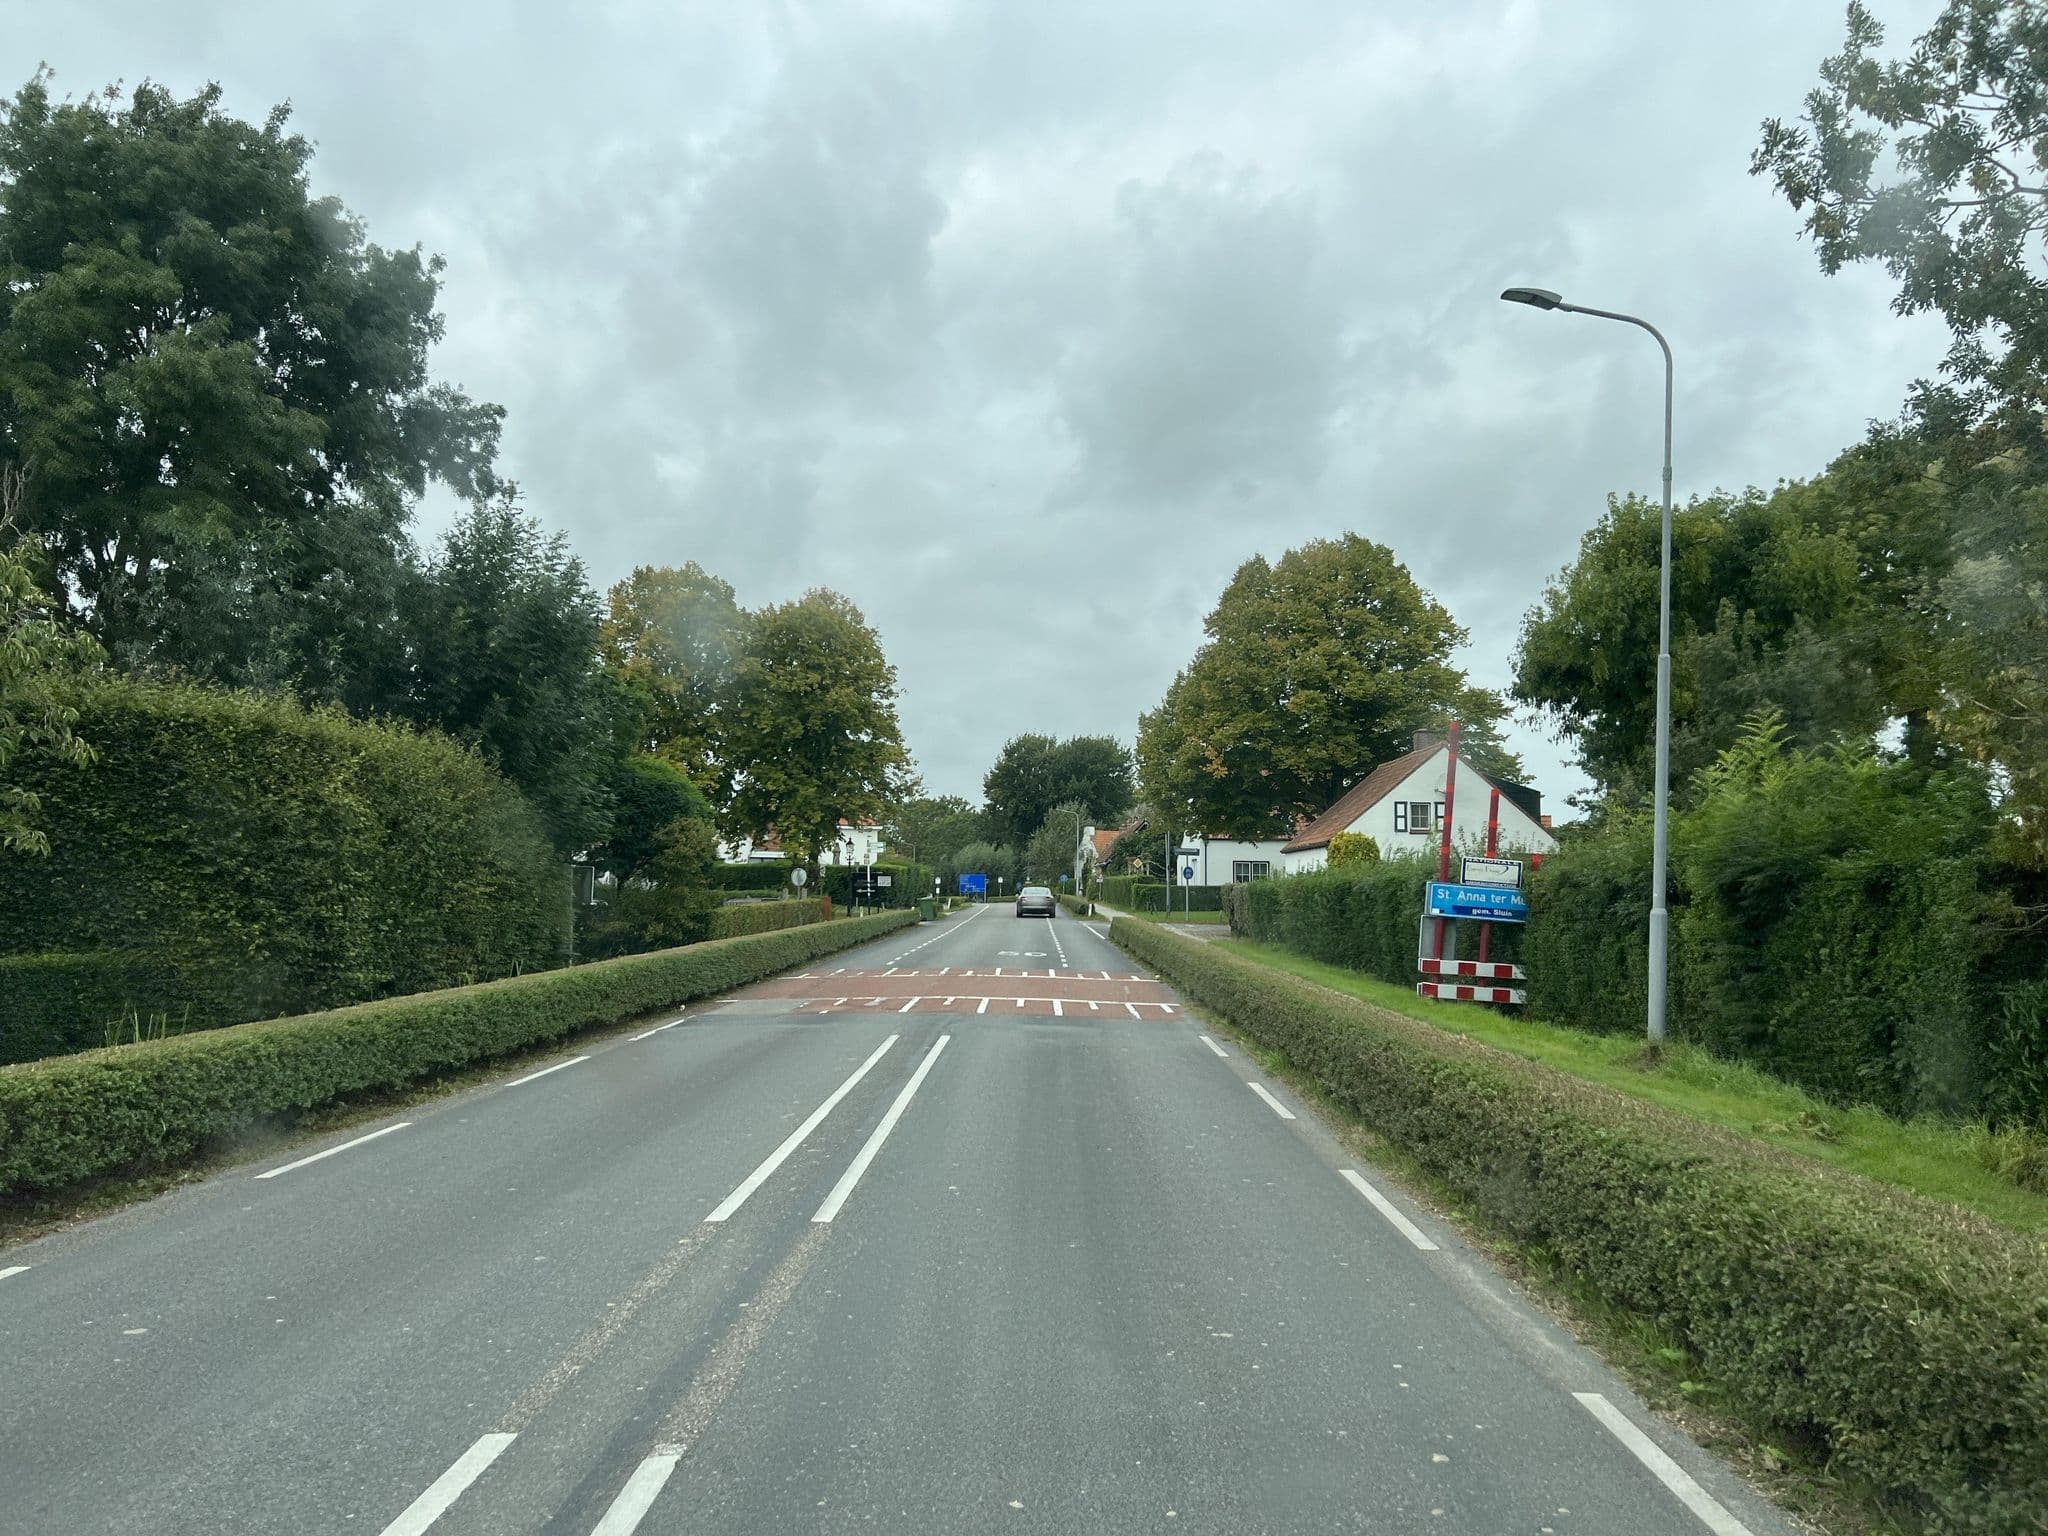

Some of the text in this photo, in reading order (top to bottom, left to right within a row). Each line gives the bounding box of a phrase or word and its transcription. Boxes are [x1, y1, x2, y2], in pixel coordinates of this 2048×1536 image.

[1438, 888, 1452, 900] St.
[1457, 890, 1486, 902] Anna
[1491, 895, 1506, 904] ter
